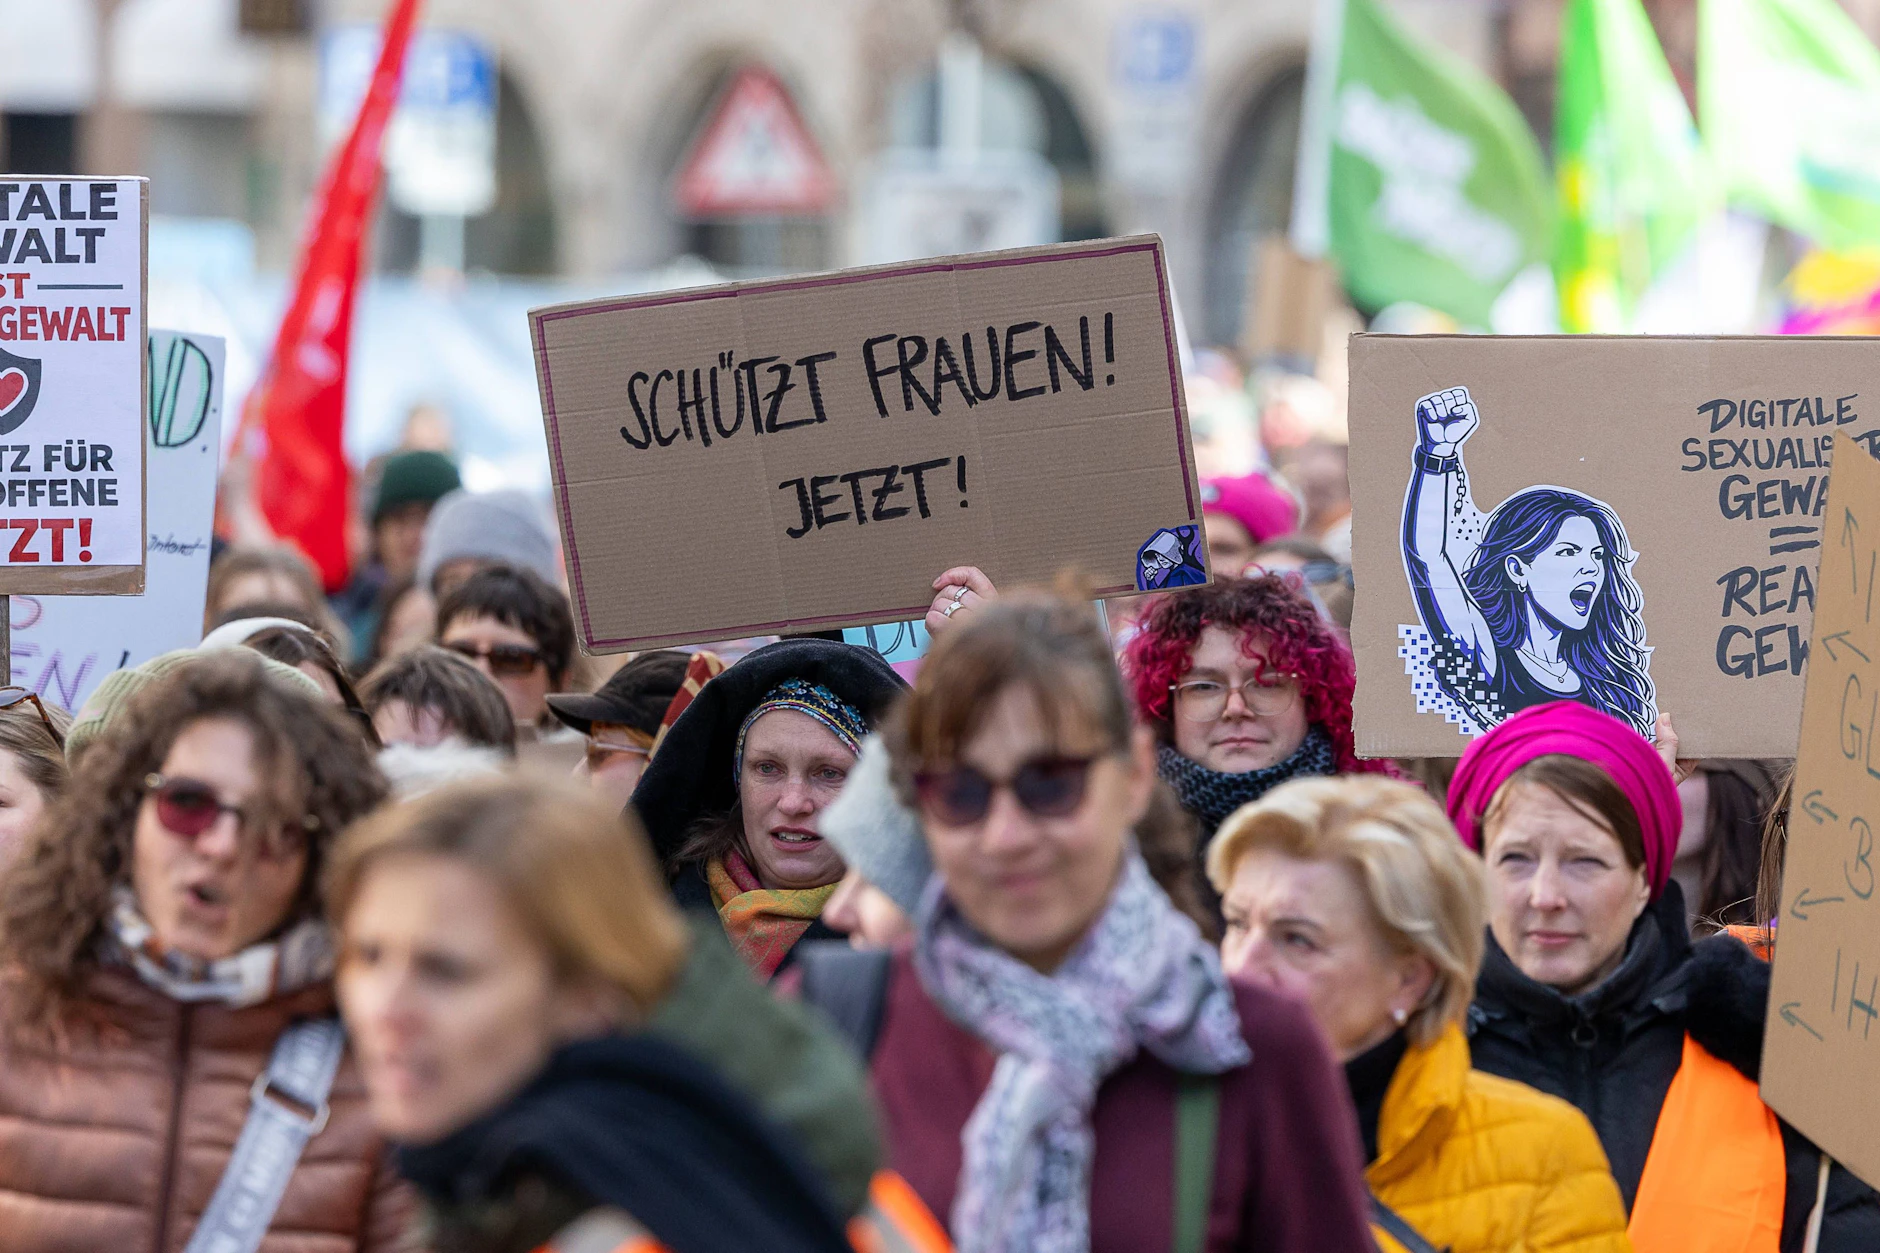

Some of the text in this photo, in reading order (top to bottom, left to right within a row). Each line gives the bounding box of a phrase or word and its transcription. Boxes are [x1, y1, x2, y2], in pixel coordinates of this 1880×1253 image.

[0, 183, 118, 221] TALE
[0, 305, 131, 342] GEWALT
[620, 312, 1115, 449] SCHÜTZT FRAUEN!
[1696, 393, 1859, 434] DIGITALE
[43, 438, 115, 473] FÜR
[778, 454, 969, 540] JETZT!
[0, 517, 93, 563] ZT!
[1716, 564, 1818, 618] REA
